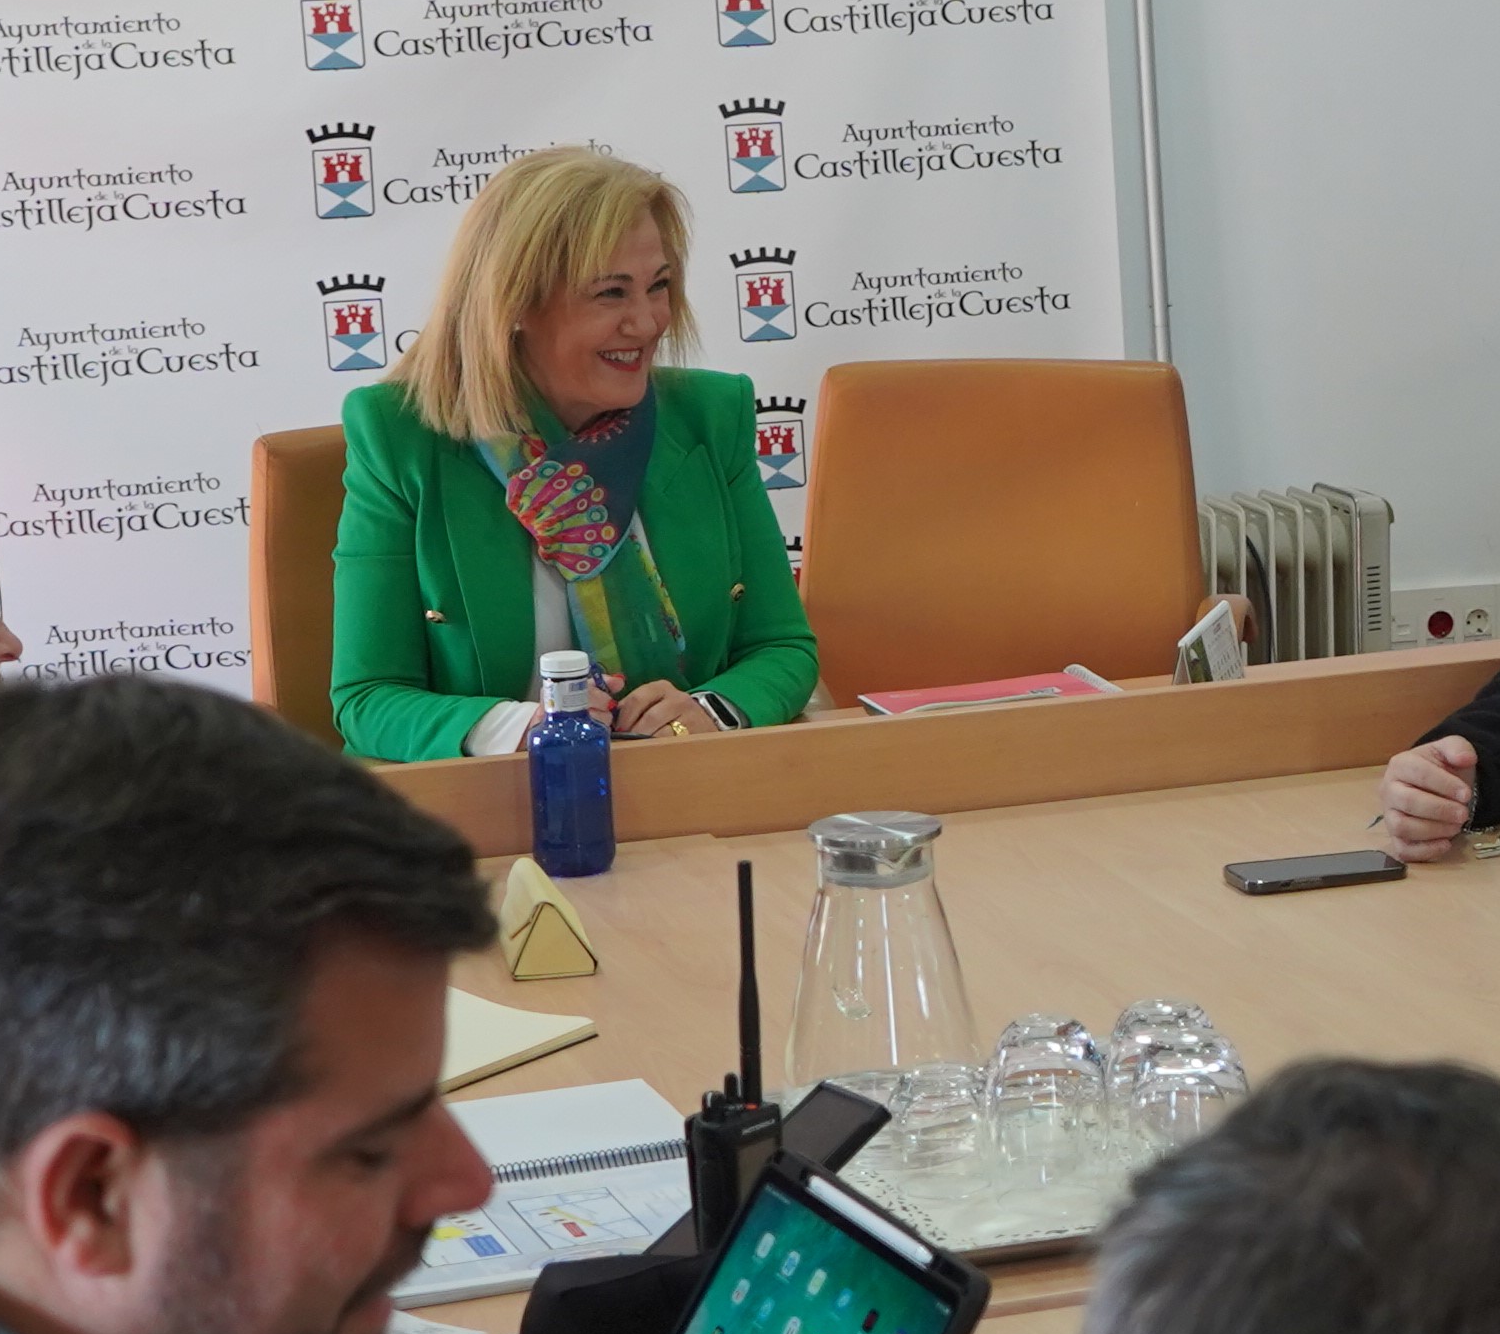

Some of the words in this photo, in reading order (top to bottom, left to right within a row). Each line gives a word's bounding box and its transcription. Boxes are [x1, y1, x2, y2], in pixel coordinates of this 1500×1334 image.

[842, 115, 1014, 145] Ayuntamiento
[1, 164, 193, 194] Ayuntamiento
[851, 262, 1023, 294] Ayuntamiento
[18, 317, 205, 349] Ayuntamiento
[33, 472, 220, 503] Ayuntamiento
[45, 617, 234, 647] Ayuntamiento
